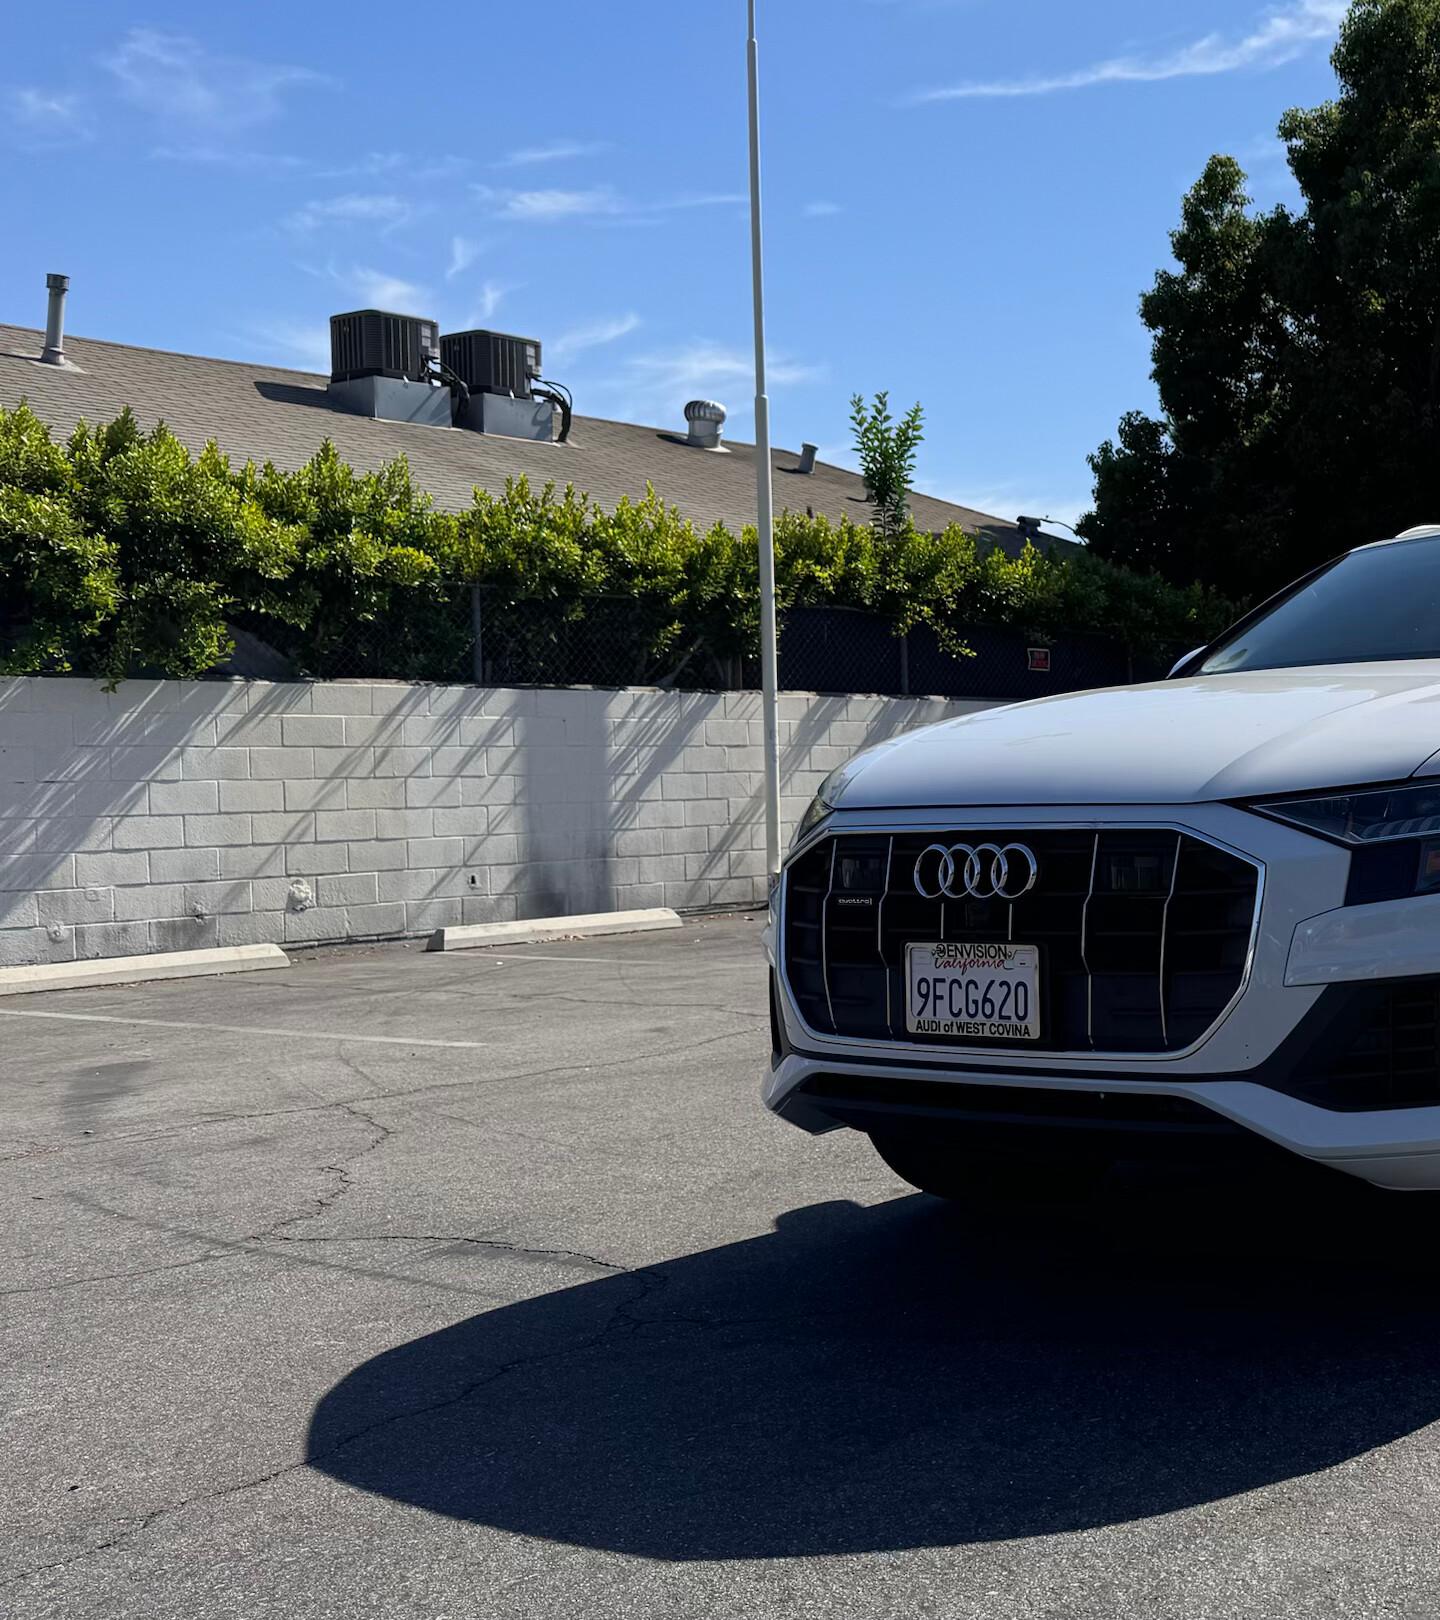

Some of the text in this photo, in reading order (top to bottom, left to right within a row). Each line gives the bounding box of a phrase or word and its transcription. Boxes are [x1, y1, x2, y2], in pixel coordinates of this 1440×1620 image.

[946, 943, 1008, 960] ENVISION
[916, 977, 1028, 1021] 9FCG620
[915, 1019, 1031, 1038] AUDI of WEST COVINA
